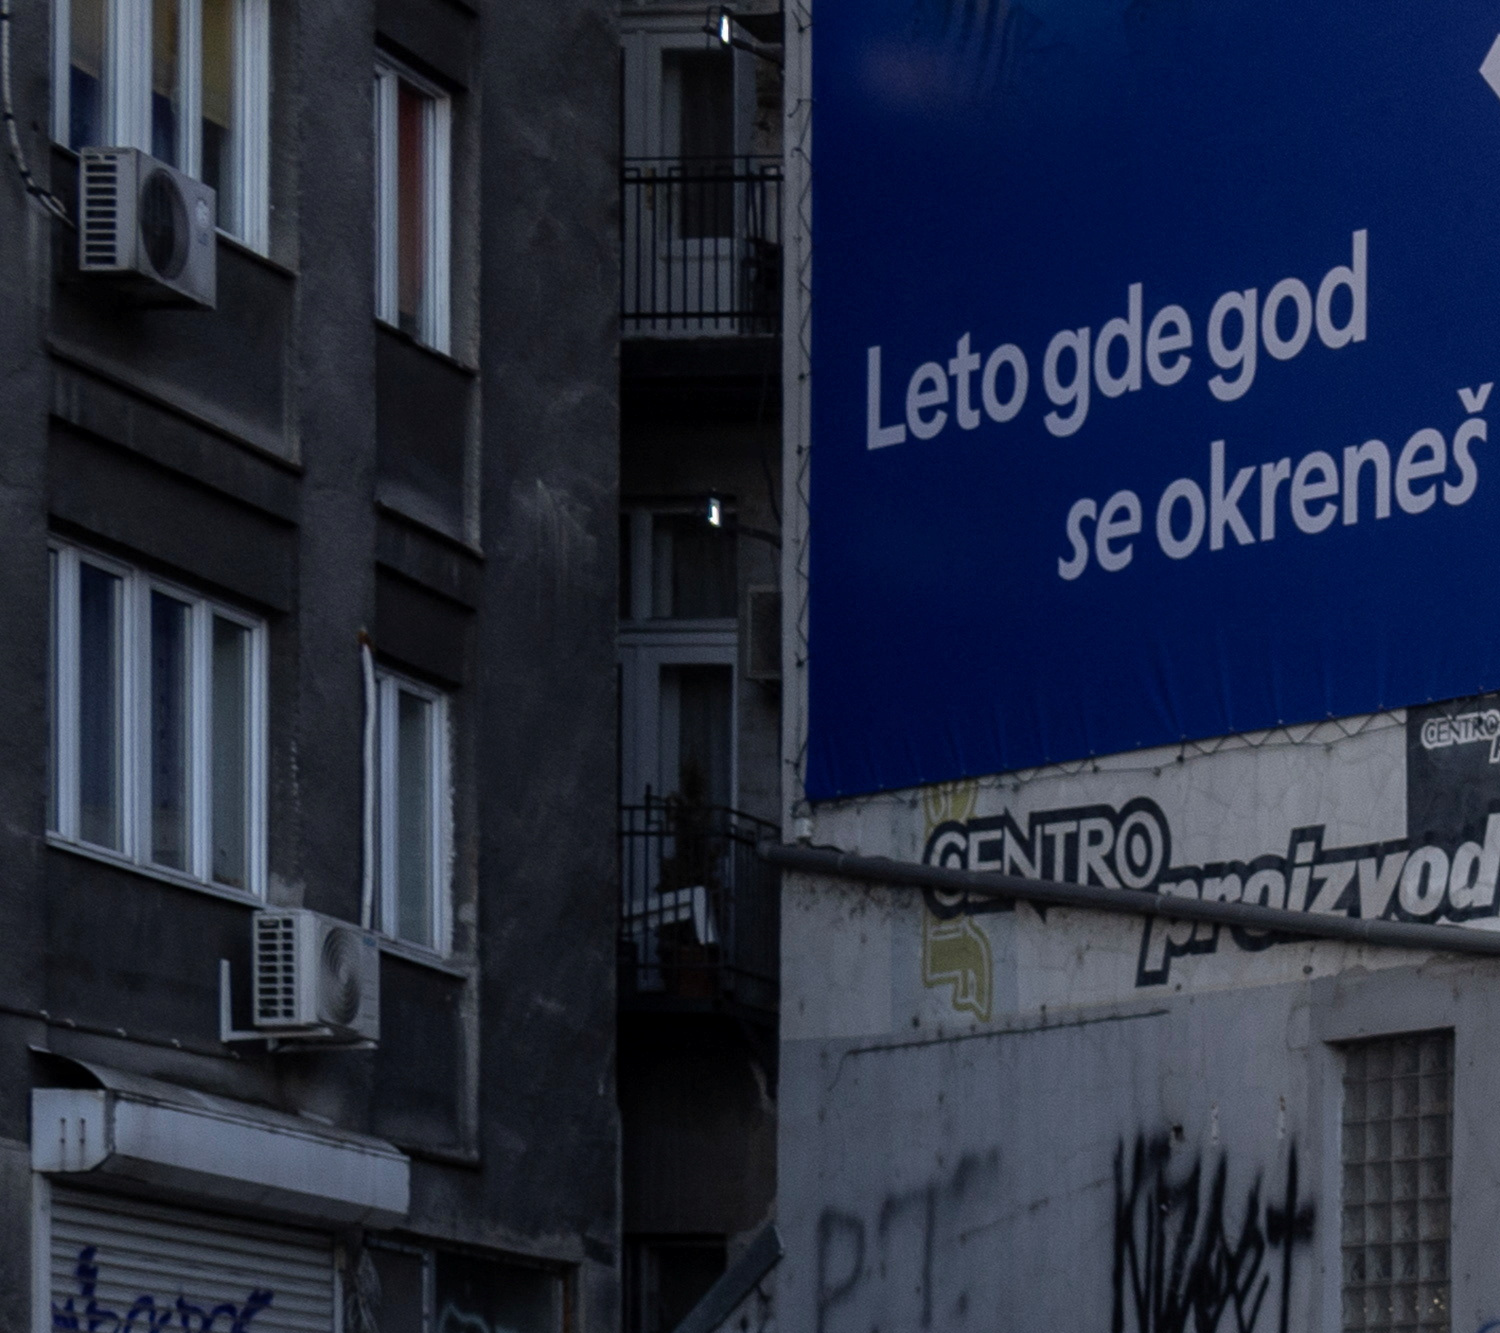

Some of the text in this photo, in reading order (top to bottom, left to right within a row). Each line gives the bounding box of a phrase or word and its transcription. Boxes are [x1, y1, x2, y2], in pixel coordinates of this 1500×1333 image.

[867, 229, 1368, 450] Leto gde god
[1058, 382, 1495, 581] se okreneš
[1422, 710, 1500, 748] CENTRO
[928, 799, 1168, 915] CENTRO
